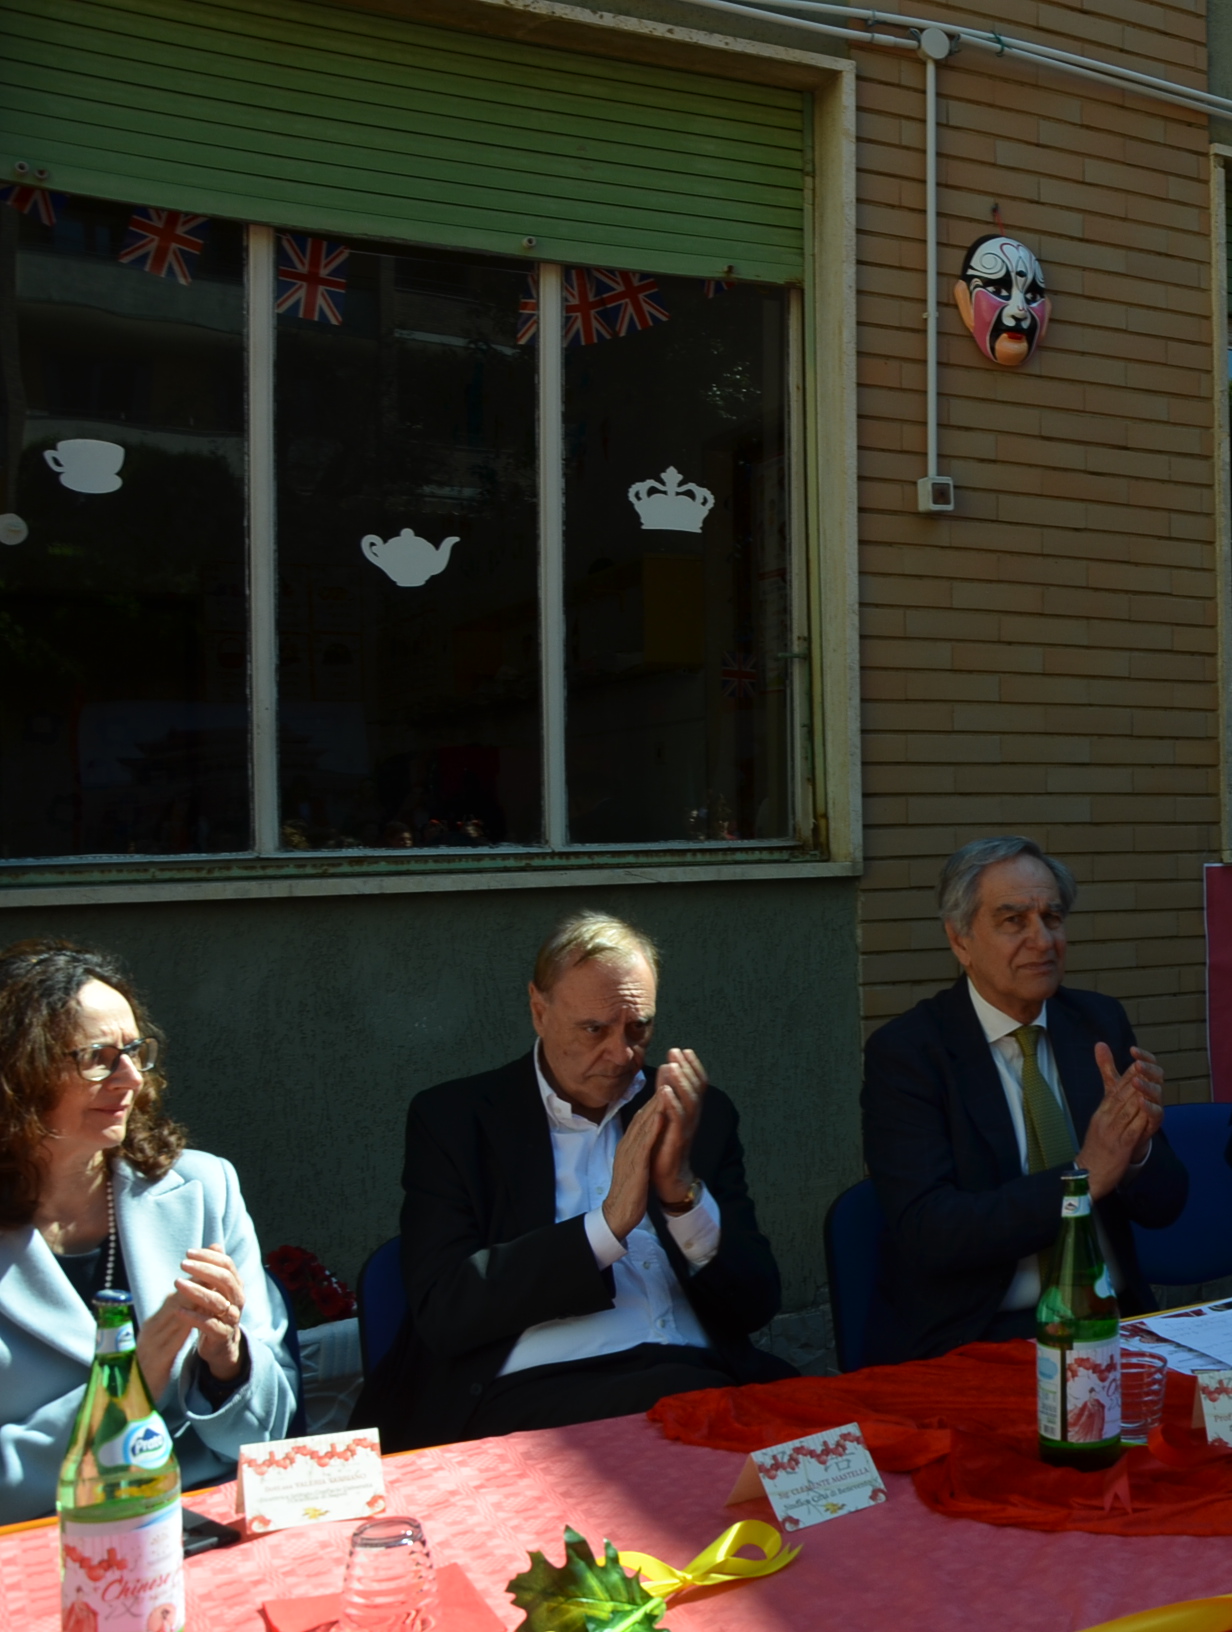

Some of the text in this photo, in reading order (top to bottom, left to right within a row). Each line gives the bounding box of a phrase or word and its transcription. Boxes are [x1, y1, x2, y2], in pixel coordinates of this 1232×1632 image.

[790, 1478, 831, 1495] CLEMENTE
[831, 1467, 870, 1482] MASTELLA
[101, 1573, 171, 1602] Chinese
